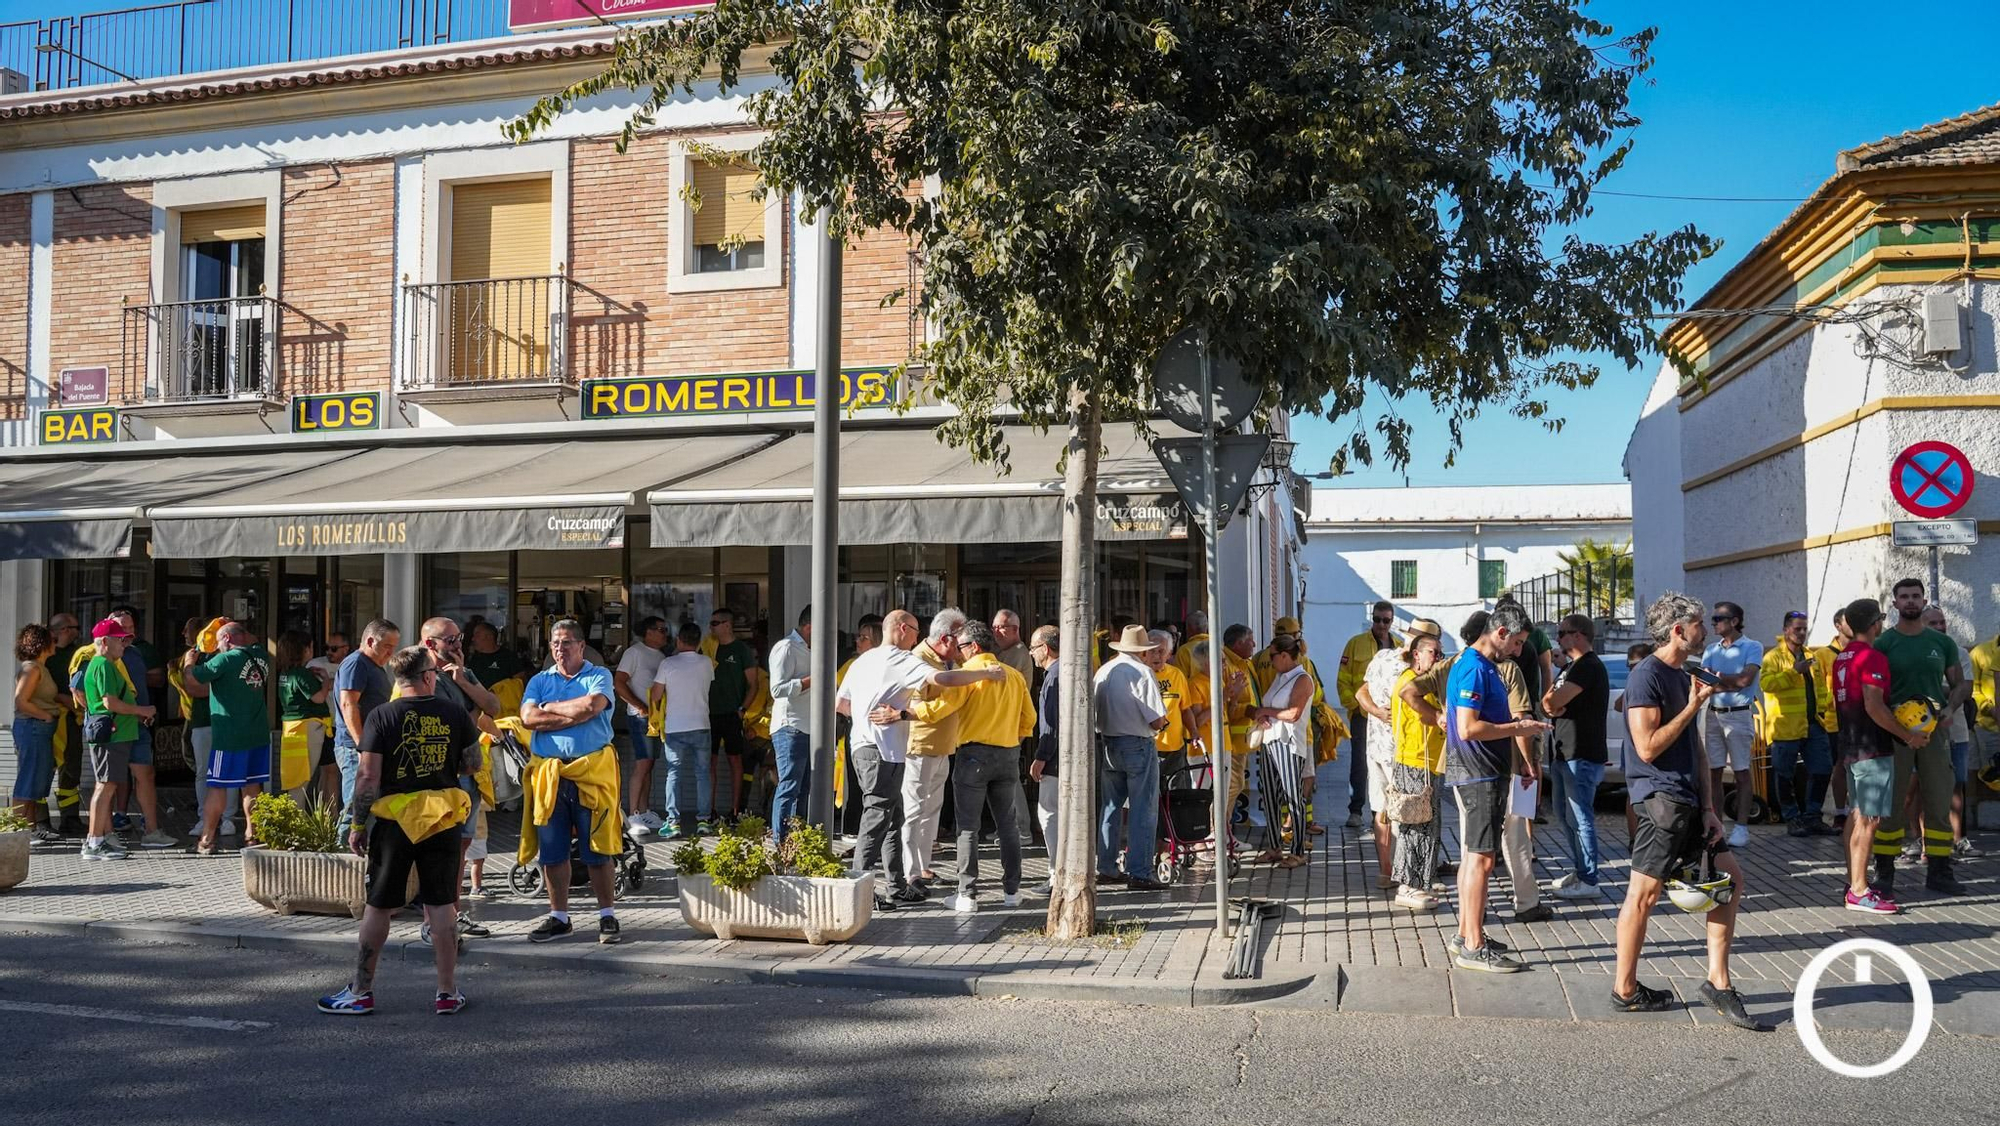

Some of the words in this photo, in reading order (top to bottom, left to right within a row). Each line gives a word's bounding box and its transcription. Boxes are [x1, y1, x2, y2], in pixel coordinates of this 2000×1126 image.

[74, 383, 95, 392] Bajada
[79, 393, 100, 401] Puente
[300, 397, 374, 429] LOS
[45, 412, 113, 442] BAR
[1095, 500, 1181, 520] Cruzcampo
[1113, 521, 1163, 532] ESPECIAL
[1917, 523, 1952, 531] EXCEPTO
[277, 525, 306, 547] LOS
[312, 521, 407, 546] ROMERILLOS
[561, 532, 602, 542] ESPECIAL
[421, 716, 440, 727] BOM
[421, 725, 451, 736] BEROS
[421, 744, 448, 754] FORES
